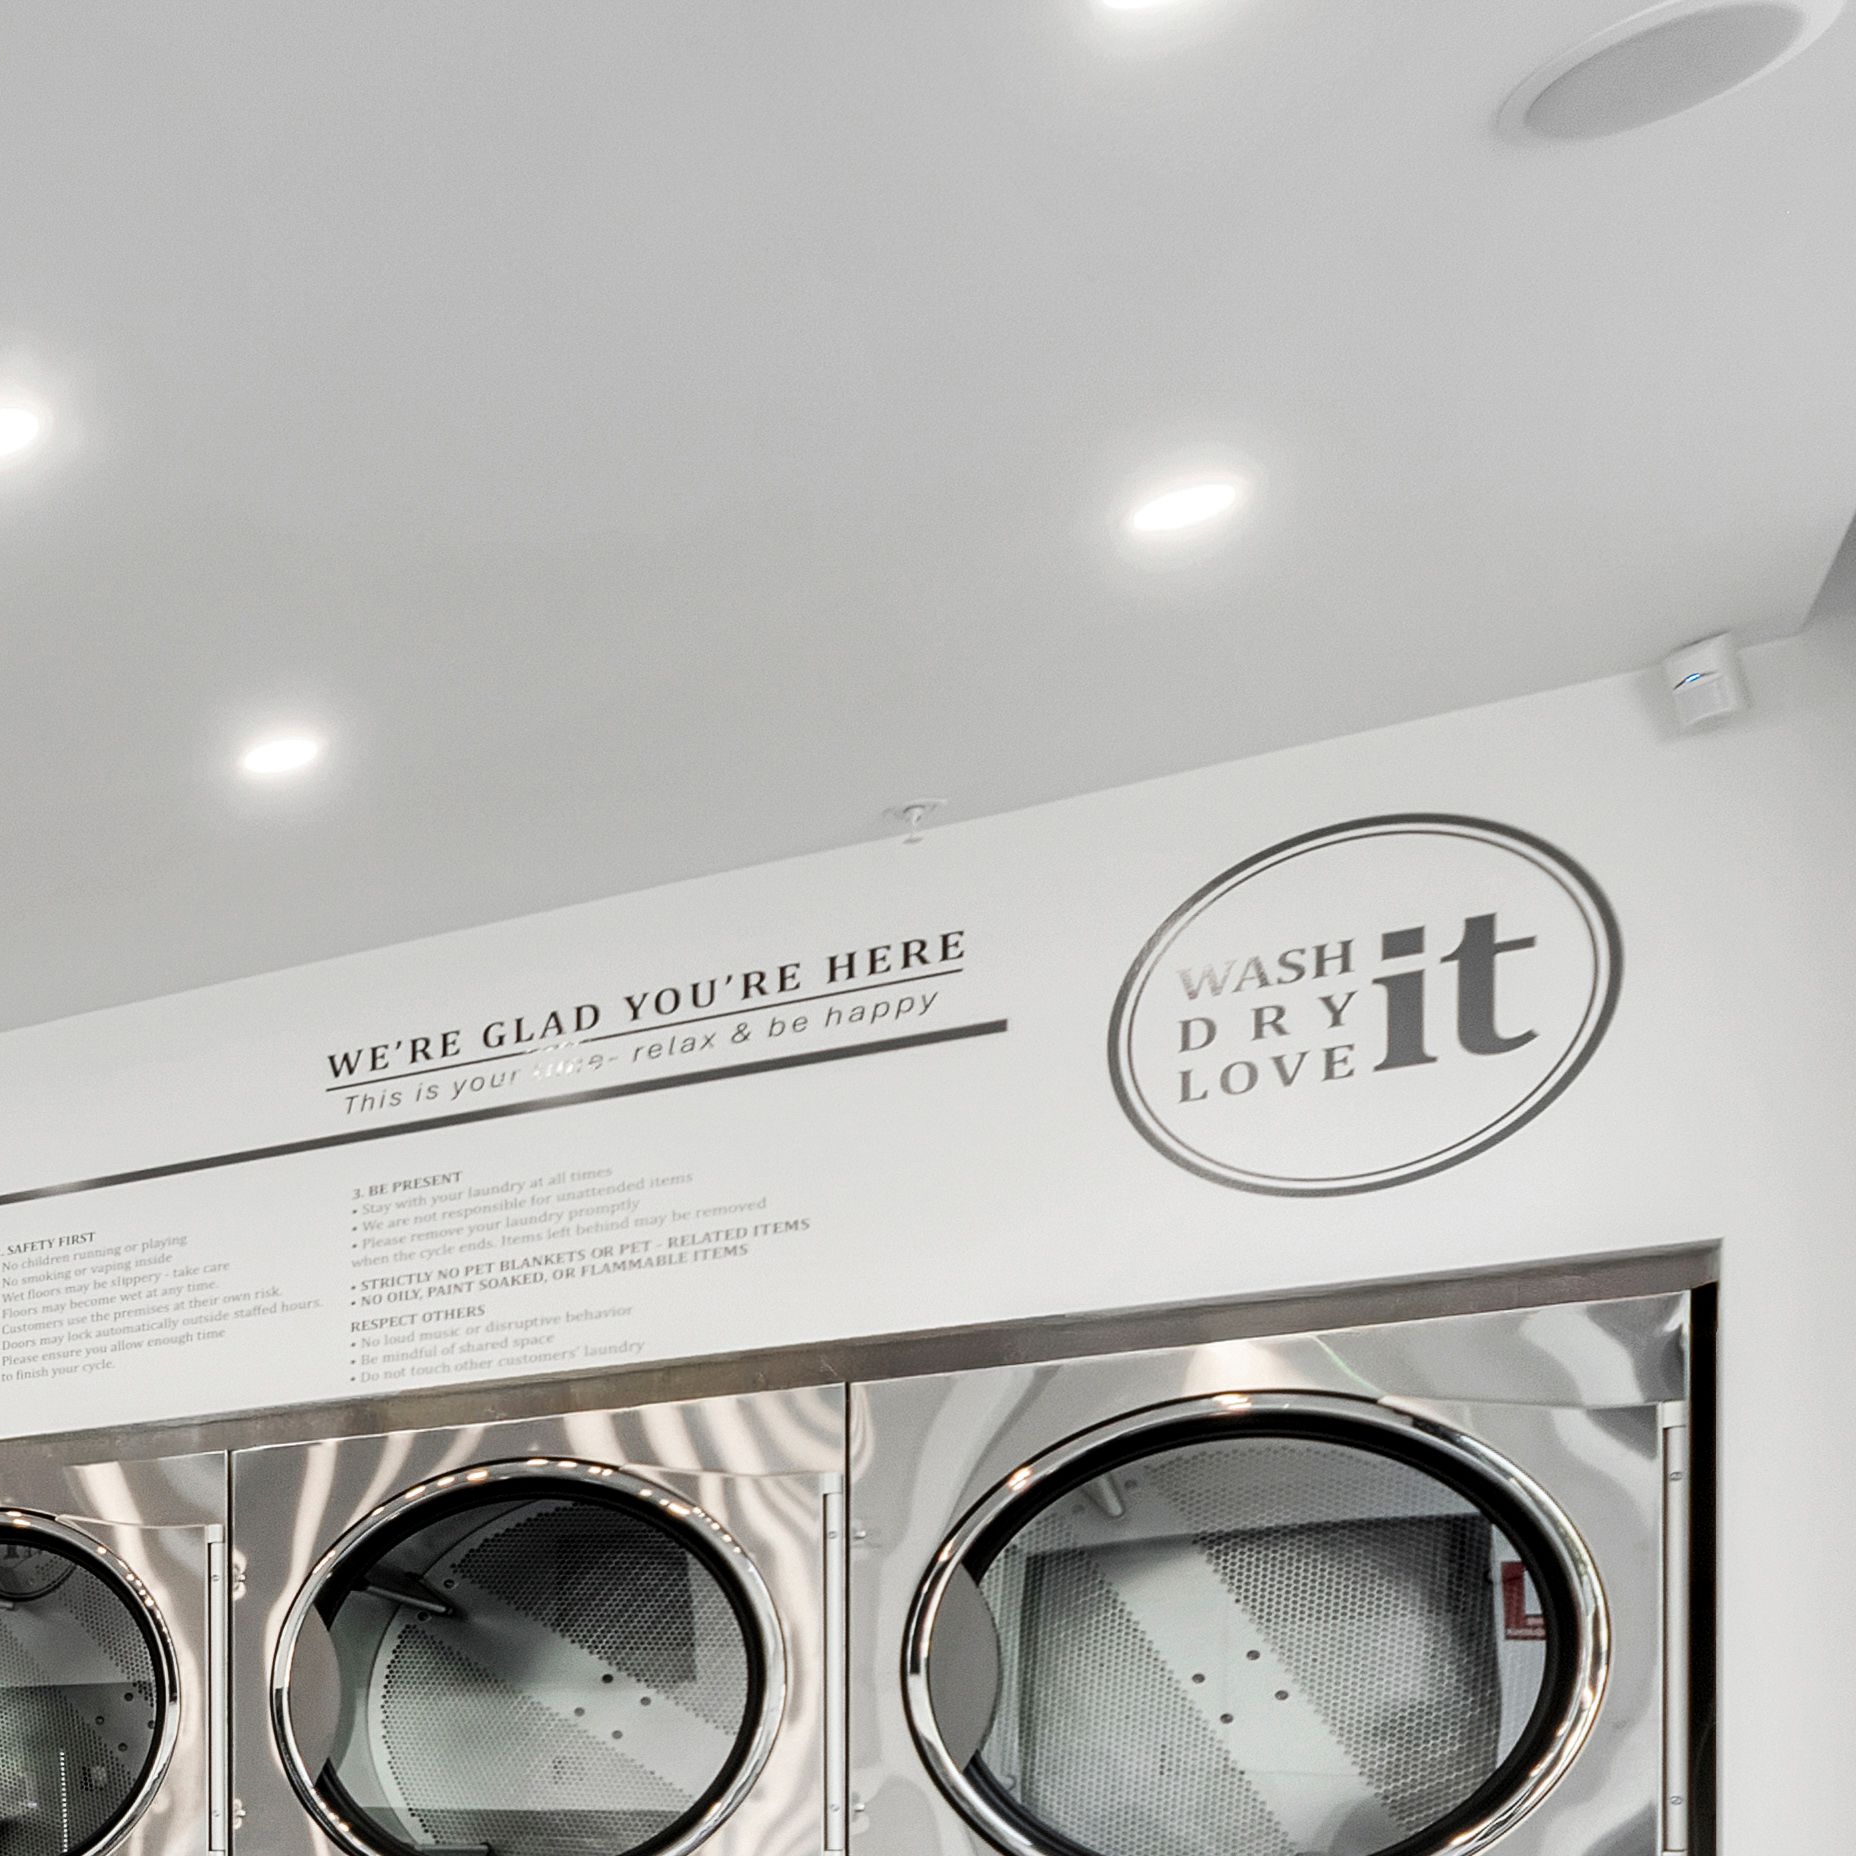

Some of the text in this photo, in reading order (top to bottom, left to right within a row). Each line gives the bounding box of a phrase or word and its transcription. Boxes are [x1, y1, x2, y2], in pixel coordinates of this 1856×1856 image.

[482, 1004, 601, 1048] GLAD
[624, 962, 802, 1022] YOU'RE
[826, 930, 966, 983] HERE
[1176, 938, 1356, 1000] WASH
[1372, 912, 1541, 1072] it
[344, 1087, 402, 1115] This
[416, 1080, 439, 1102] is
[452, 1067, 521, 1100] your
[633, 1033, 716, 1062] relax
[731, 1023, 753, 1046] &
[769, 1009, 809, 1038] be
[825, 989, 939, 1028] happy
[1178, 991, 1358, 1053] DRY
[1178, 1044, 1356, 1103] LOVE
[352, 1171, 459, 1199] 3. BE PRESENT
[1, 1254, 172, 1287] No smoking or vaping inside
[7, 1238, 53, 1255] SAFETY
[58, 1231, 93, 1246] FIRST
[361, 1217, 810, 1290] STRICTLY NO PET BLANKETS OR PET RELATED ITEMS
[360, 1243, 748, 1306] NO OILY, PAINT SOAKED, OR FLAMMABLE ITEMS
[350, 1304, 485, 1332] RESPECT OTHERS
